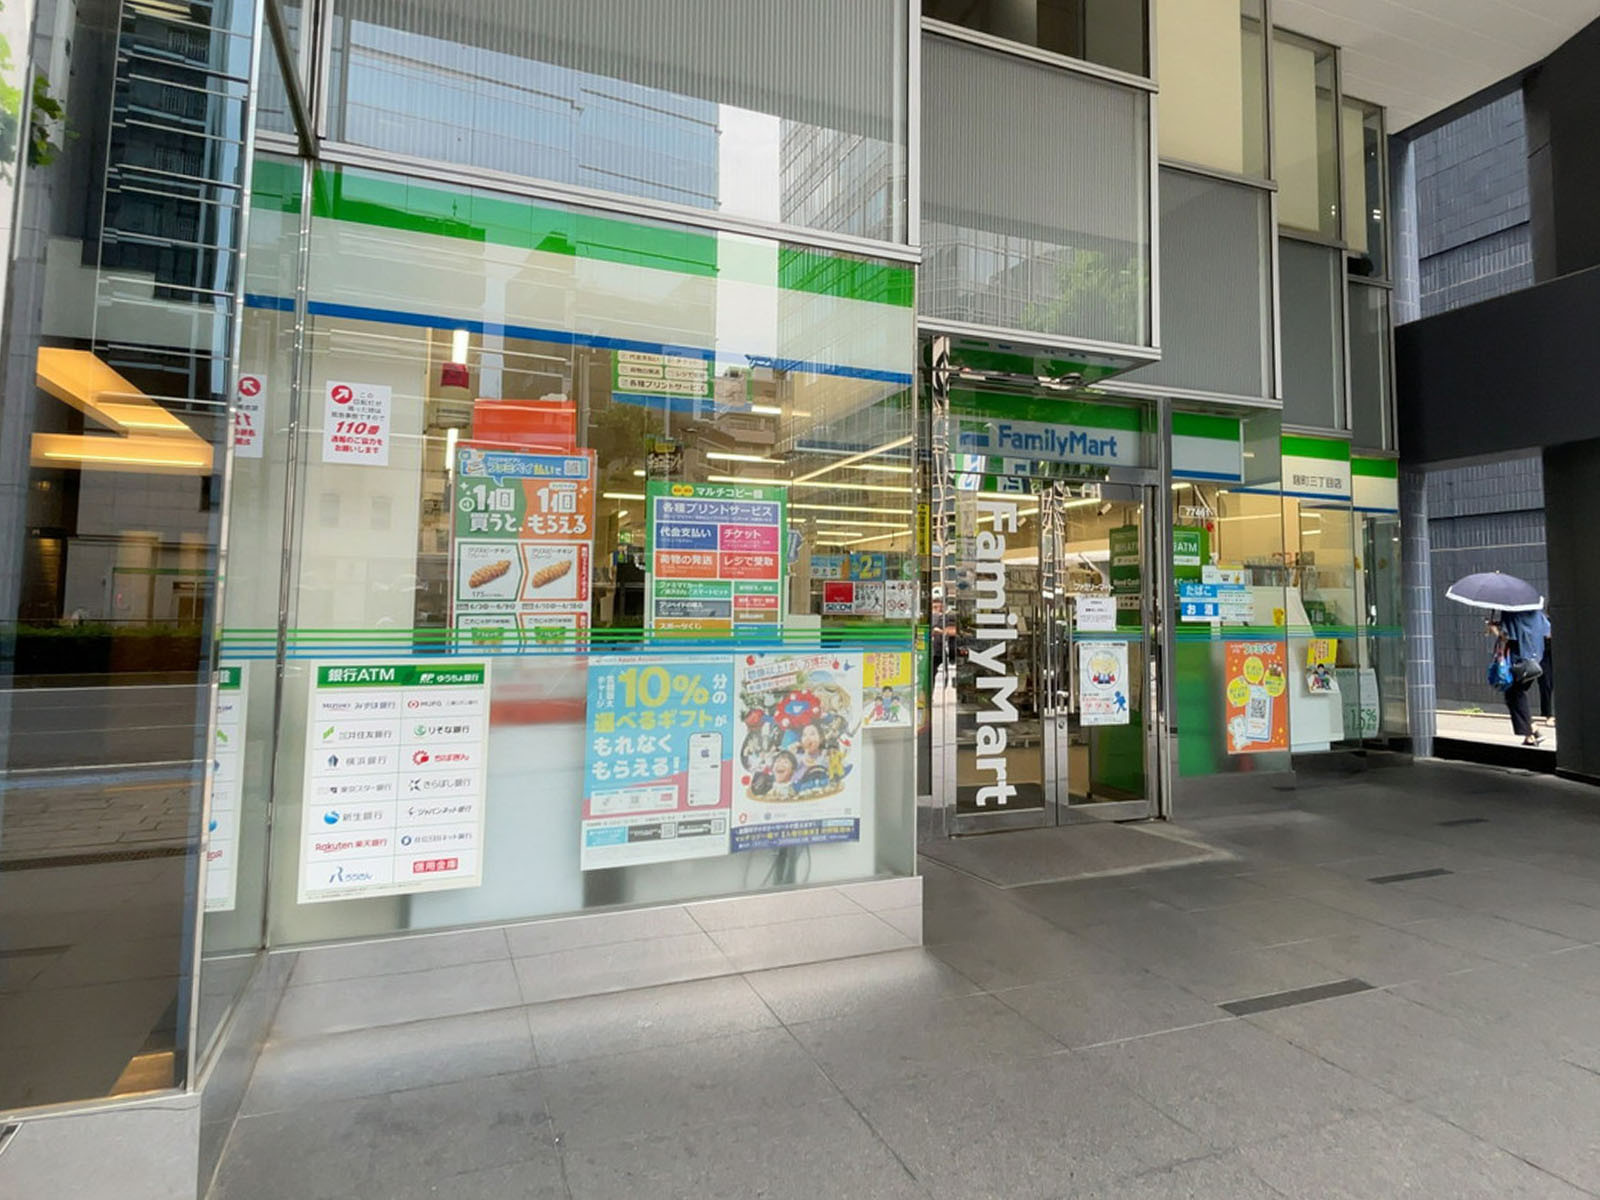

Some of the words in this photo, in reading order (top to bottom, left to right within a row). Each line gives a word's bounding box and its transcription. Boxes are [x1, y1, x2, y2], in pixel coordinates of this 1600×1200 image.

[336, 420, 380, 435] 110番
[998, 424, 1118, 457] FamilyMart
[473, 484, 516, 511] 1個
[536, 487, 577, 513] 1個
[663, 502, 772, 517] 各種プリントサービス
[528, 514, 588, 534] もらえる
[660, 527, 712, 538] 代金支払い
[724, 529, 761, 540] チケット
[724, 556, 774, 567] レジで受取
[968, 501, 1018, 807] FamilyMart
[328, 667, 396, 682] 銀行ATM
[436, 673, 479, 683] ゆうちょ銀行
[618, 665, 710, 708] 10%
[354, 701, 396, 711] みずほ銀行
[339, 730, 392, 740] 三井住友銀行
[428, 725, 470, 735] りそな銀行
[593, 733, 672, 756] もれなく
[345, 756, 387, 766] 横浜銀行
[423, 778, 472, 789] きらぼし銀行
[343, 811, 383, 822] 新生銀行
[315, 842, 354, 852] Rakuten
[355, 839, 388, 848] 楽天銀行
[413, 859, 458, 873] 信用金庫
